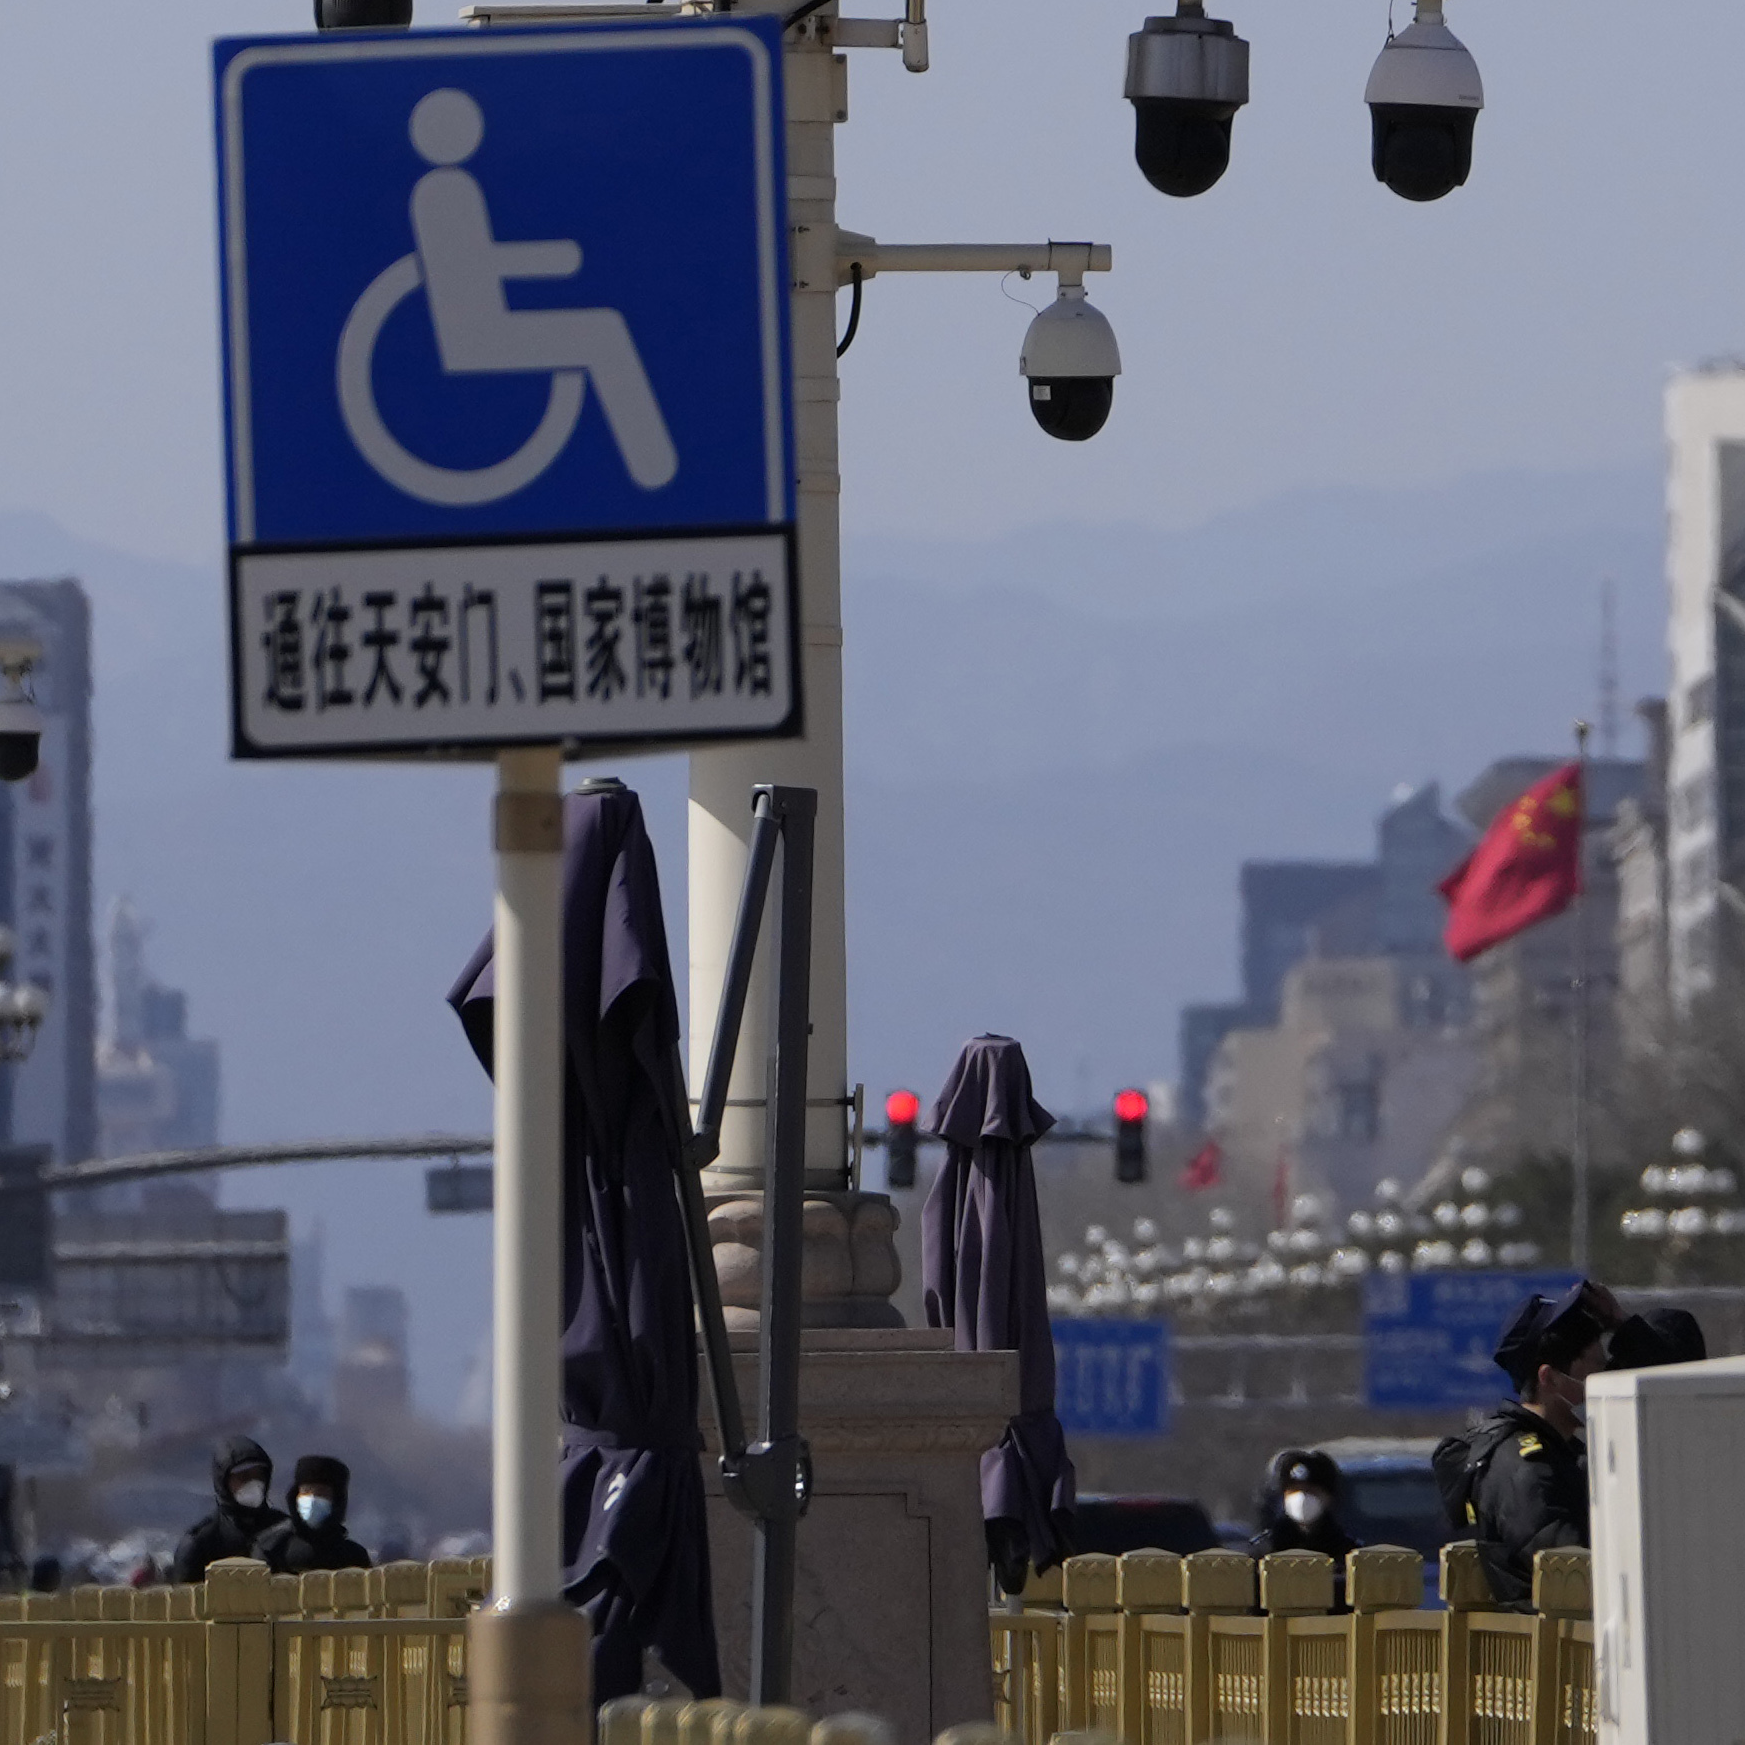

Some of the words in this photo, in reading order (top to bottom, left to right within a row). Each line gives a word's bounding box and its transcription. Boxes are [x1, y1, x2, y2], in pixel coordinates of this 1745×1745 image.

[261, 569, 772, 713] 通往天安门、国家博物馆
